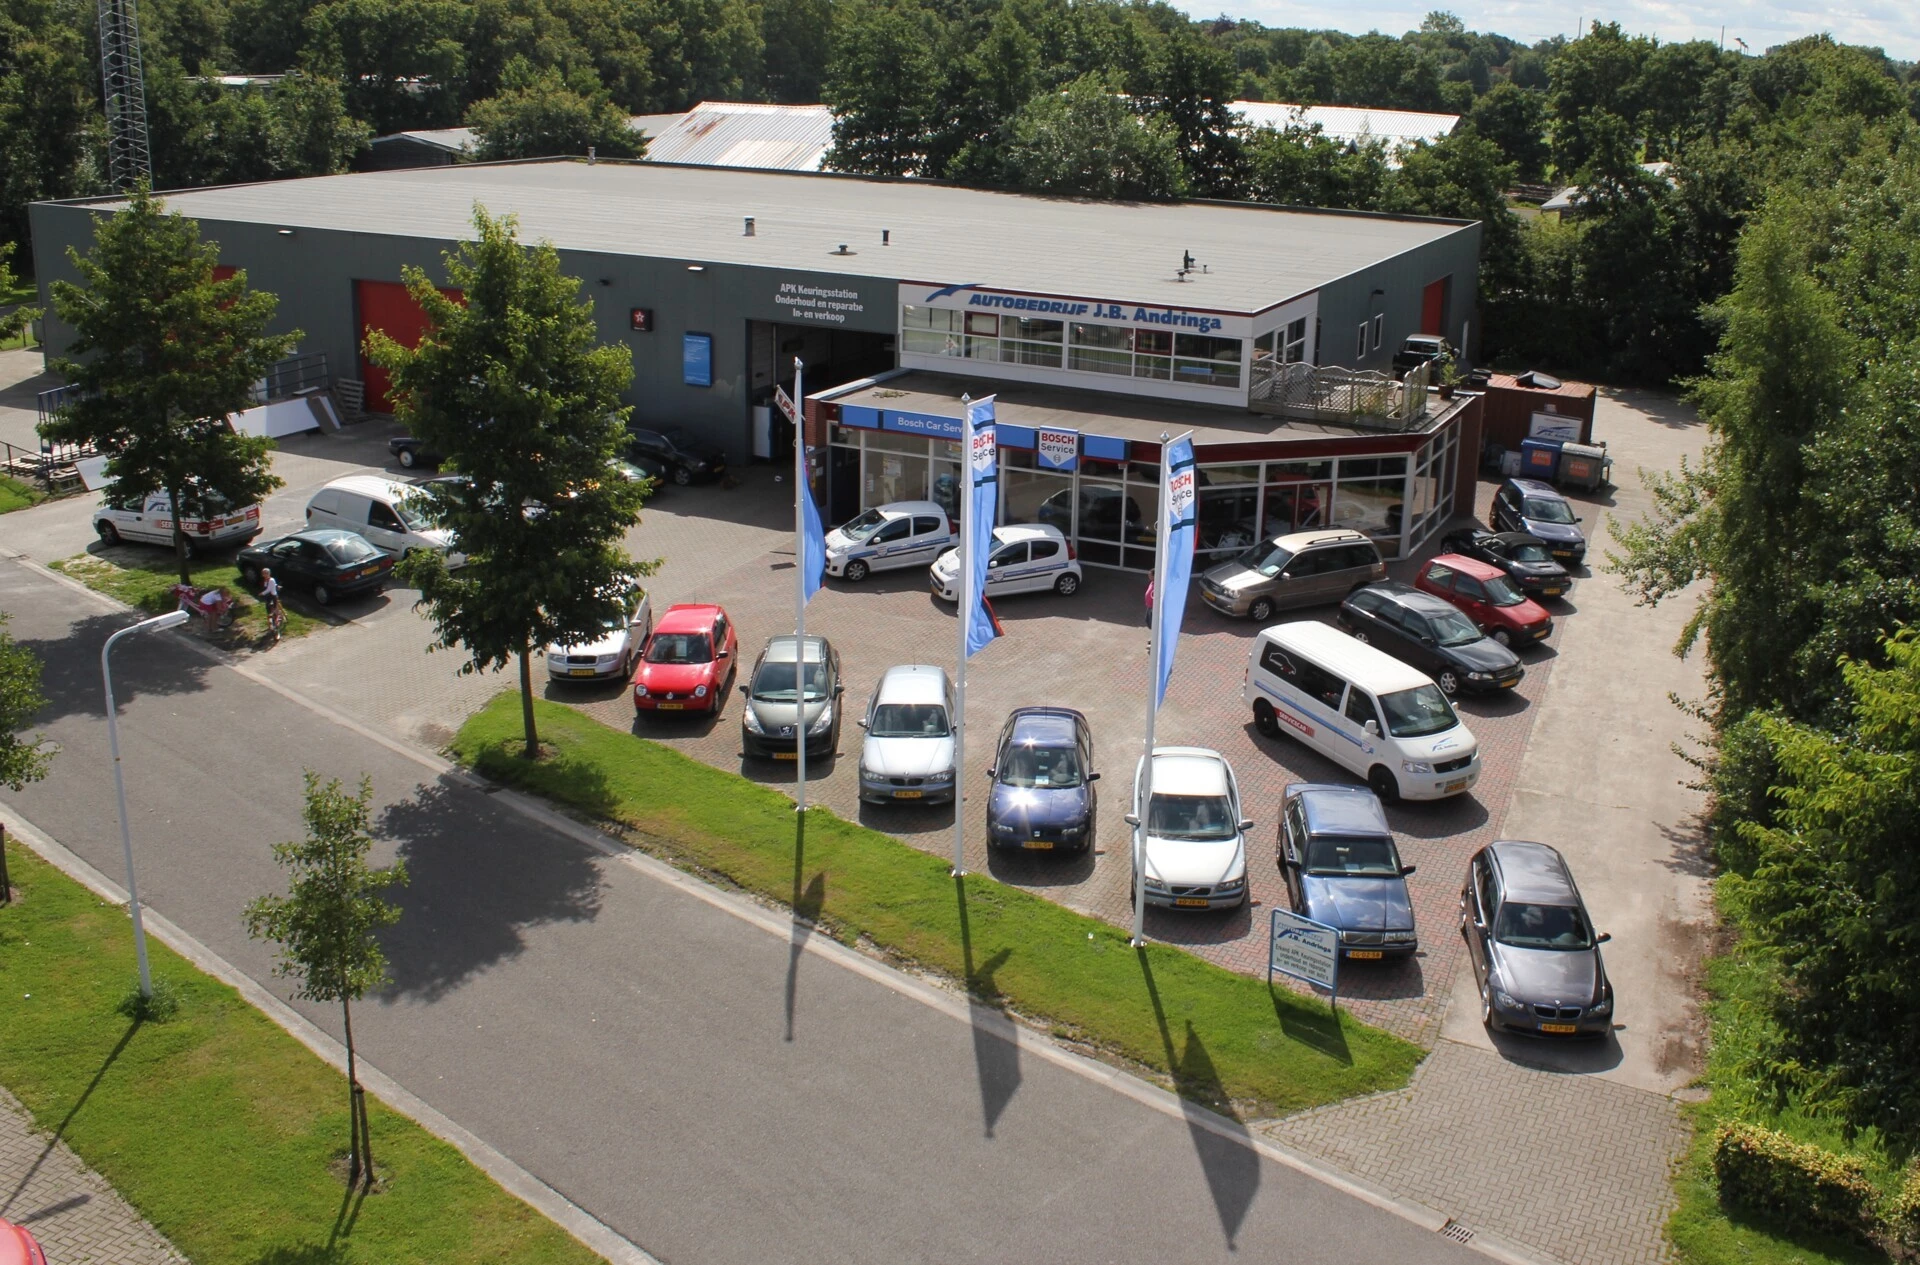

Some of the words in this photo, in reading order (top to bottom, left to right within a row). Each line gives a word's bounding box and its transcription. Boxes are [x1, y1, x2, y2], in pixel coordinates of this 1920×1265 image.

[780, 283, 797, 294] APK
[798, 284, 858, 299] Keuringsstation
[775, 294, 816, 308] Onderhoud
[817, 300, 827, 309] en
[828, 300, 864, 312] reparatie
[792, 307, 802, 317] In-
[803, 310, 813, 319] en
[814, 311, 845, 323] verkoop
[968, 294, 1088, 316] AUTOBEDRIJF
[1093, 303, 1127, 320] J.B.
[1133, 307, 1222, 333] Andringa
[897, 416, 924, 429] Bosch
[926, 420, 942, 430] Car
[943, 422, 963, 433] Serv
[1041, 432, 1075, 445] BOSCH
[1041, 442, 1075, 455] Service
[1302, 938, 1331, 953] Andringa
